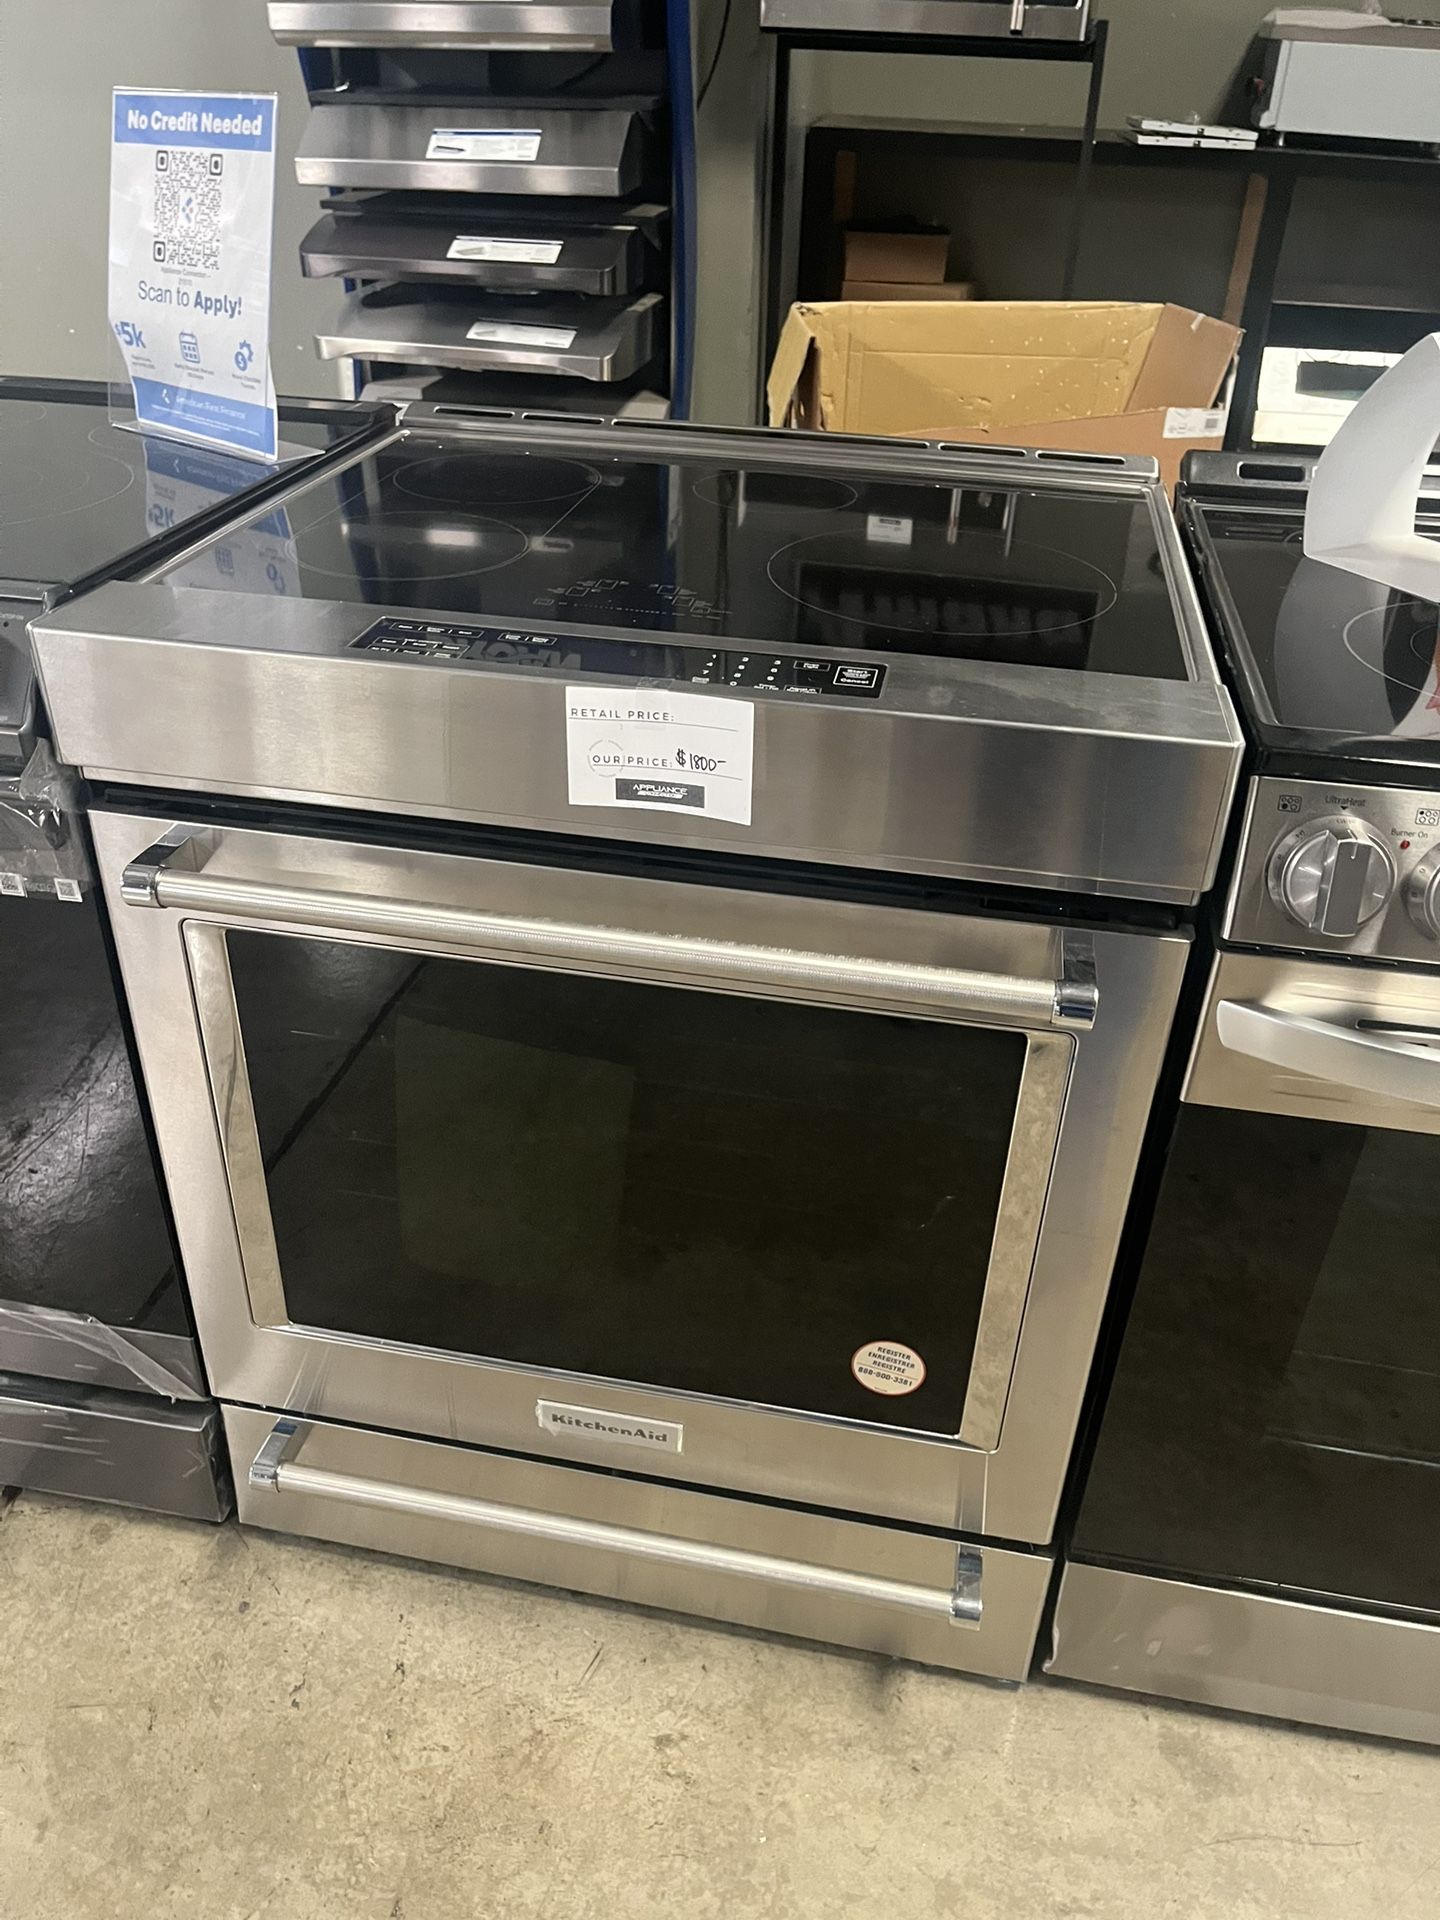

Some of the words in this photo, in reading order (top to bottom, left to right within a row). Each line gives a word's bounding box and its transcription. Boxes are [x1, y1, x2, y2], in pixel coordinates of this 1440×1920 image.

[127, 109, 148, 130] No
[151, 110, 199, 132] Credit
[201, 112, 263, 136] Needed
[138, 280, 172, 304] Scan
[176, 287, 190, 307] to
[194, 290, 243, 319] Apply!
[570, 708, 621, 719] RETAIL
[628, 710, 675, 722] PRICE:
[592, 755, 622, 765] OUR
[627, 756, 673, 768] PRICE:
[632, 783, 689, 796] APPLIANCE
[1390, 828, 1416, 838] Burner
[1417, 831, 1429, 839] On
[877, 1346, 911, 1361] REGISTER
[551, 1413, 668, 1443] KitchenAid
